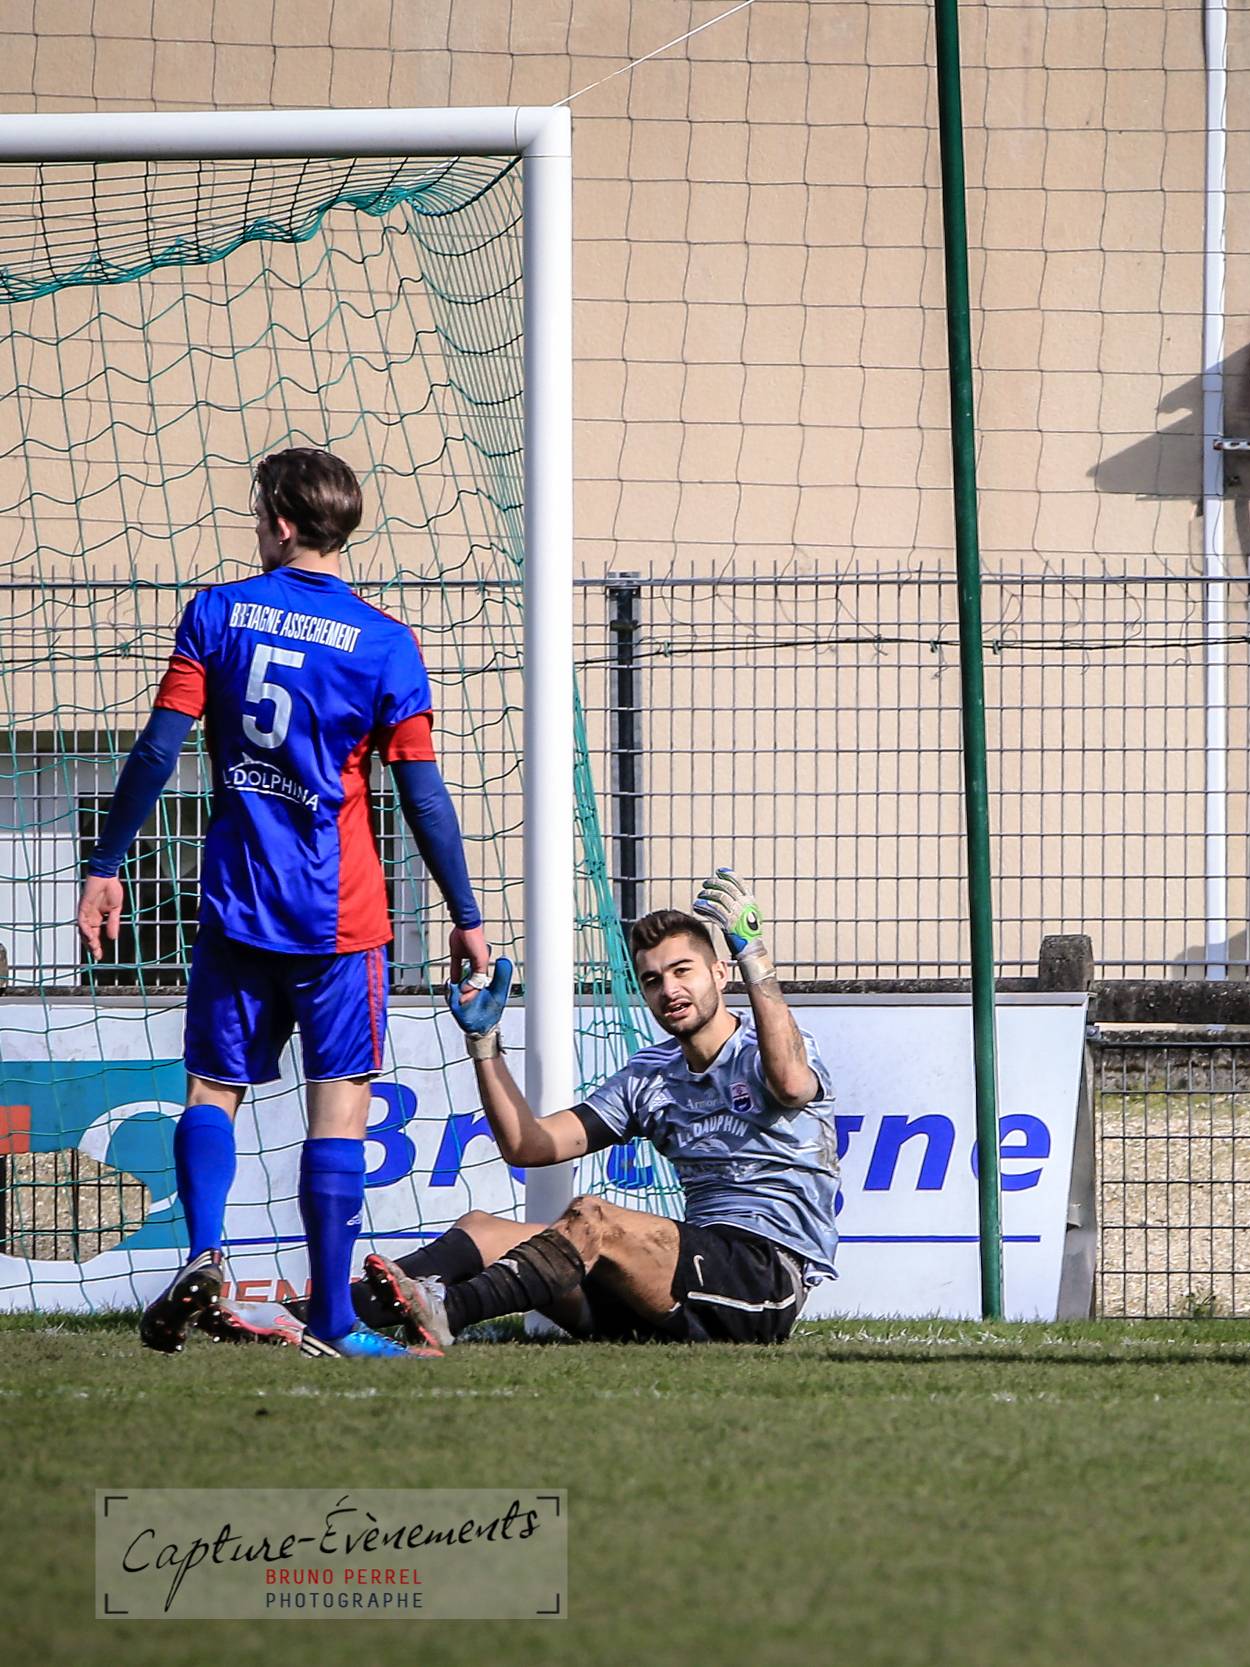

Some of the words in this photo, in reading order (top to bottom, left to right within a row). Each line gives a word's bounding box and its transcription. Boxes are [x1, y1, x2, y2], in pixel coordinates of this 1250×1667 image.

[279, 611, 361, 653] ASSECHEMENT
[242, 643, 306, 749] 5
[360, 1081, 1051, 1218] Brne
[693, 1115, 749, 1138] DAUPHIN
